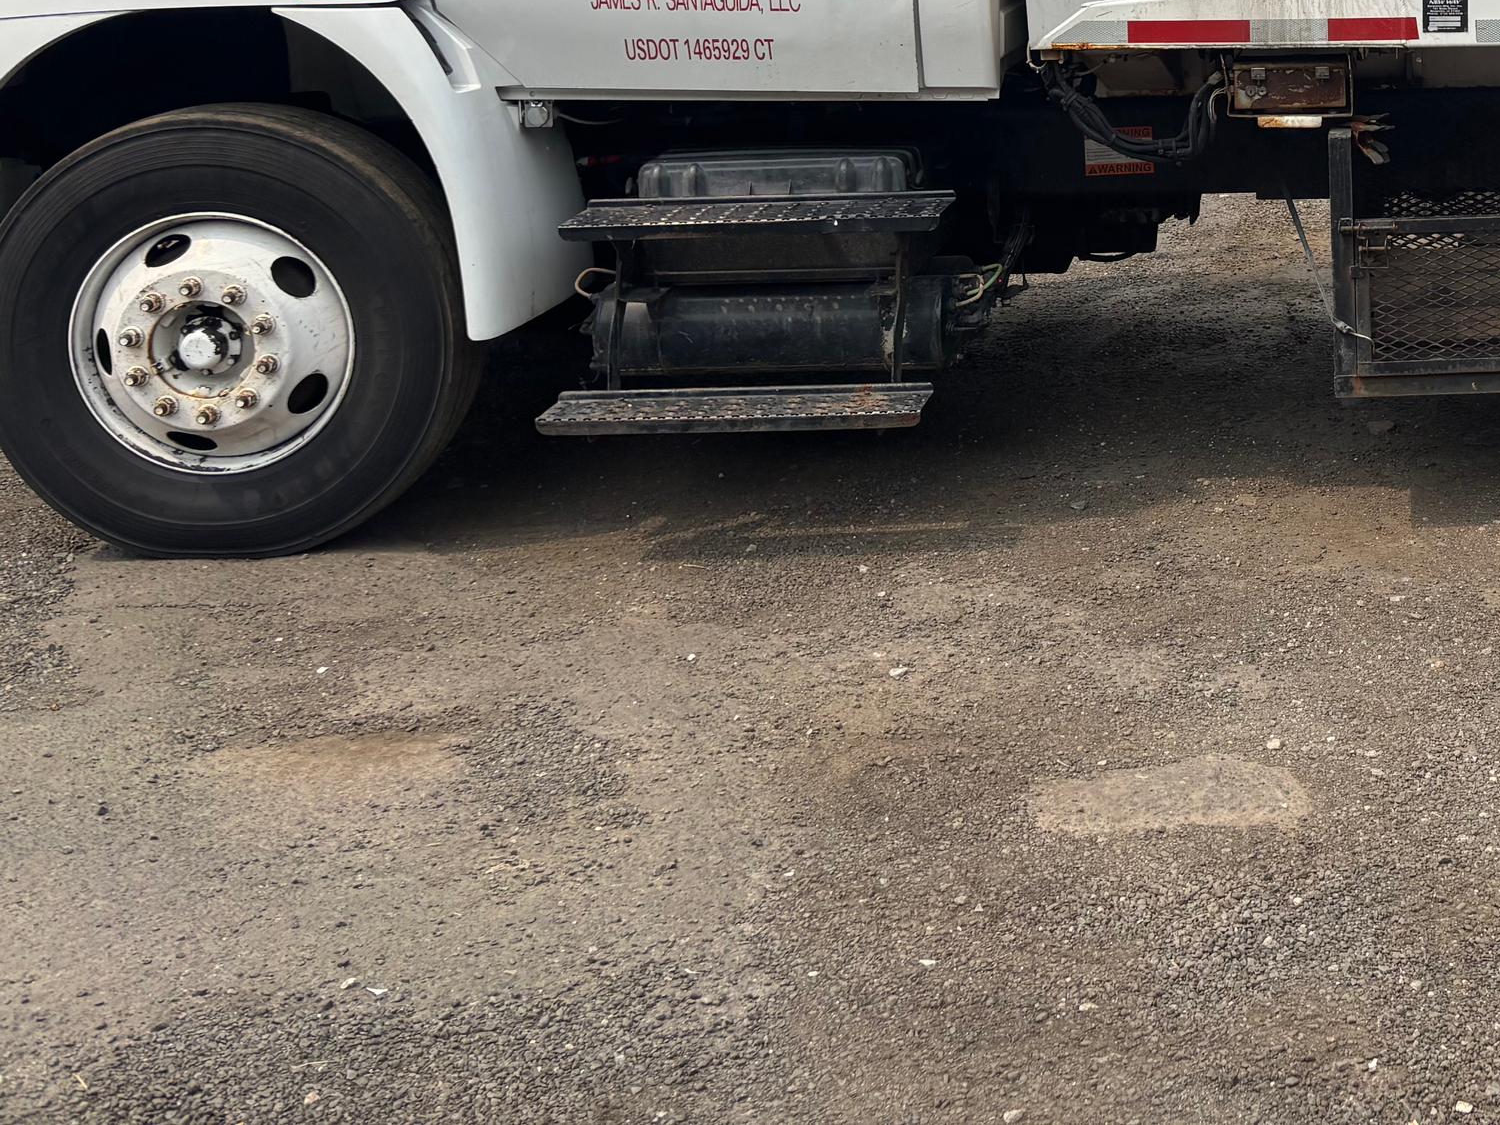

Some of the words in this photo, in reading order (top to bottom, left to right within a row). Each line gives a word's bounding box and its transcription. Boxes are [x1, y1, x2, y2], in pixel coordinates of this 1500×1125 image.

[623, 37, 680, 60] USDOT
[683, 37, 750, 61] 1465929
[753, 38, 775, 61] CT
[1098, 162, 1152, 173] WARNING
